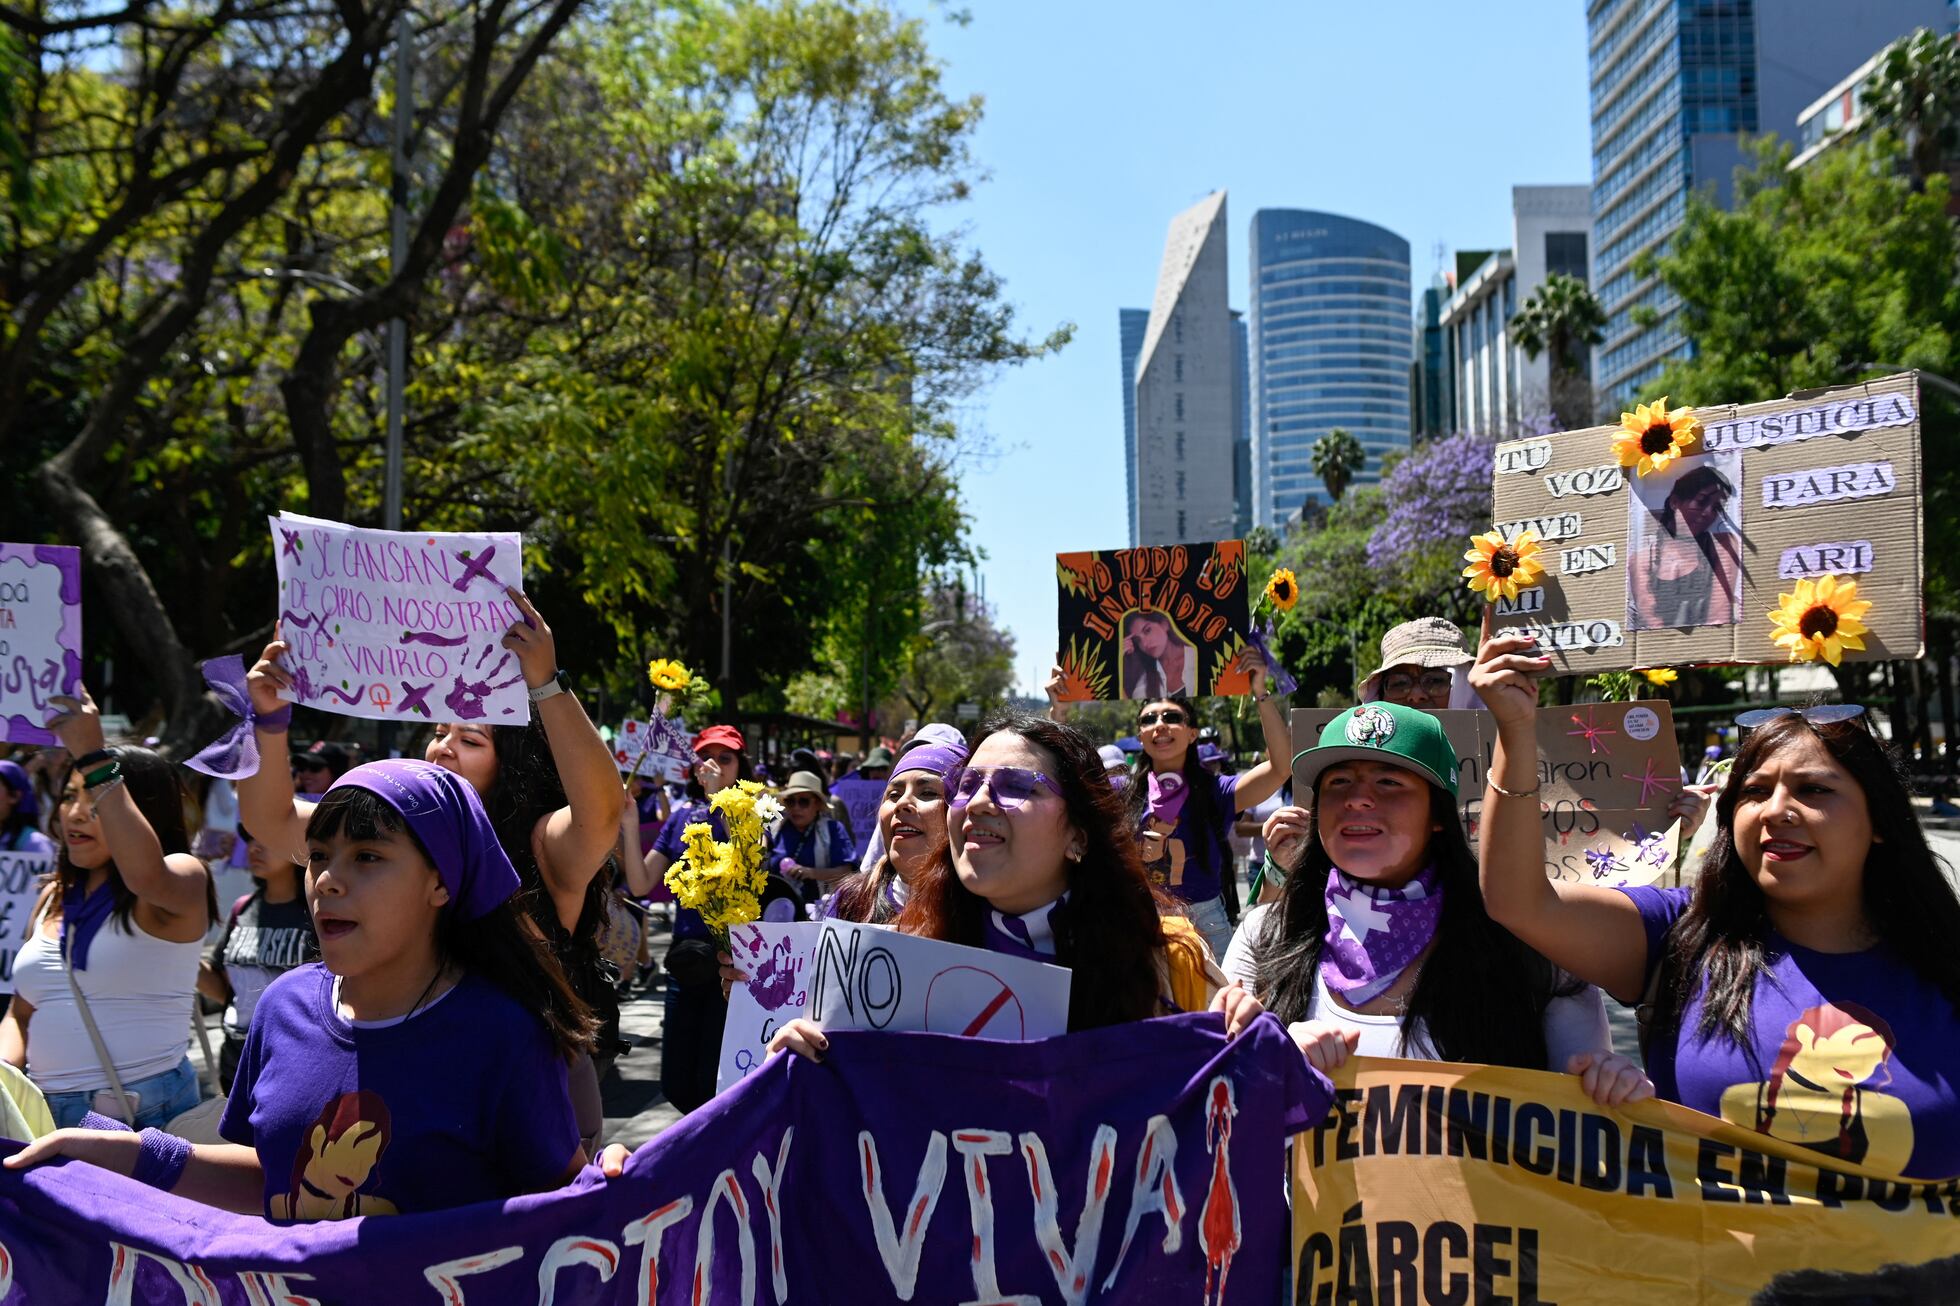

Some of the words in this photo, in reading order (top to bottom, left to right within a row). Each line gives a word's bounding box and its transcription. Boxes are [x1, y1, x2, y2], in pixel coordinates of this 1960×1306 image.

[1706, 394, 1911, 449] JUSTICIA
[1500, 446, 1548, 471] TU
[1546, 468, 1618, 496] VOZ
[1770, 465, 1891, 502] PARA
[1497, 515, 1578, 542] VIVE
[342, 538, 453, 586] CANSAN
[1114, 544, 1189, 580] TODO
[1196, 557, 1239, 600] LO
[1562, 545, 1613, 571] EN
[1784, 544, 1865, 575] ARI
[290, 576, 309, 613] DE
[384, 596, 524, 633] NOSOTRAS
[1083, 577, 1227, 643] INCENDIO
[1498, 589, 1541, 614] MI
[295, 630, 325, 664] DE
[812, 926, 902, 1030] NO
[1313, 1084, 1674, 1199] FEMINICIDA
[1697, 1137, 1792, 1206] EN
[858, 1115, 1187, 1306] VIVA
[1301, 1201, 1558, 1306] CÁRCEL
